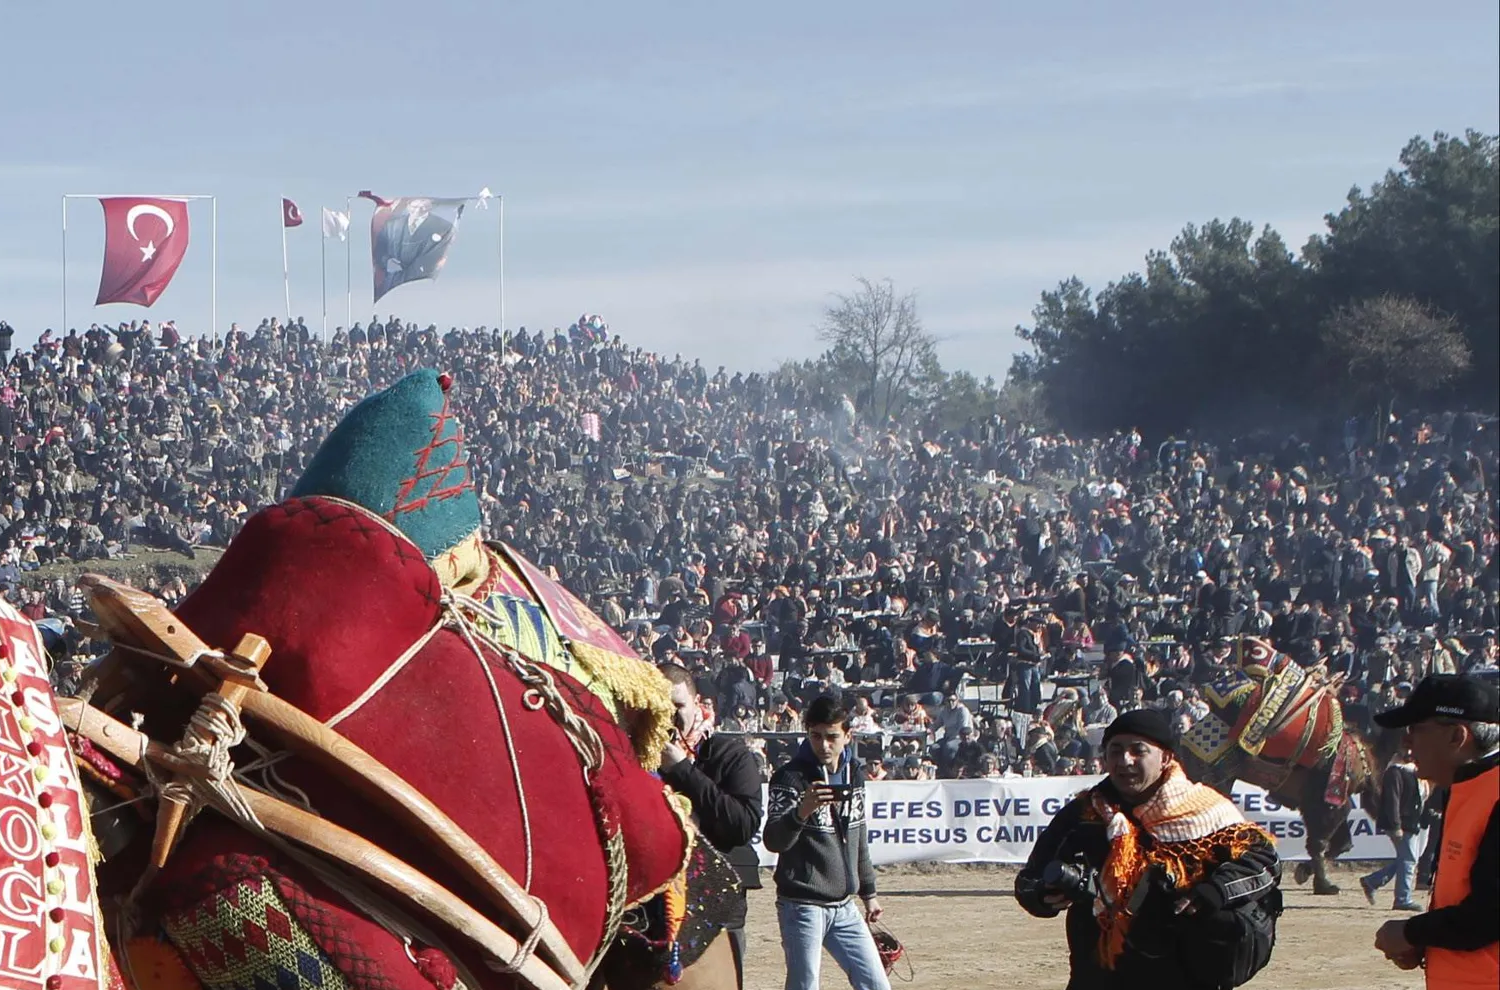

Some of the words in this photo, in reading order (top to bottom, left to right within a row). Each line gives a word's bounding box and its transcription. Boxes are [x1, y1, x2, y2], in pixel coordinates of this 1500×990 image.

[871, 801, 942, 819] EFES
[954, 798, 1031, 817] DEVE
[867, 826, 968, 844] PHESUS
